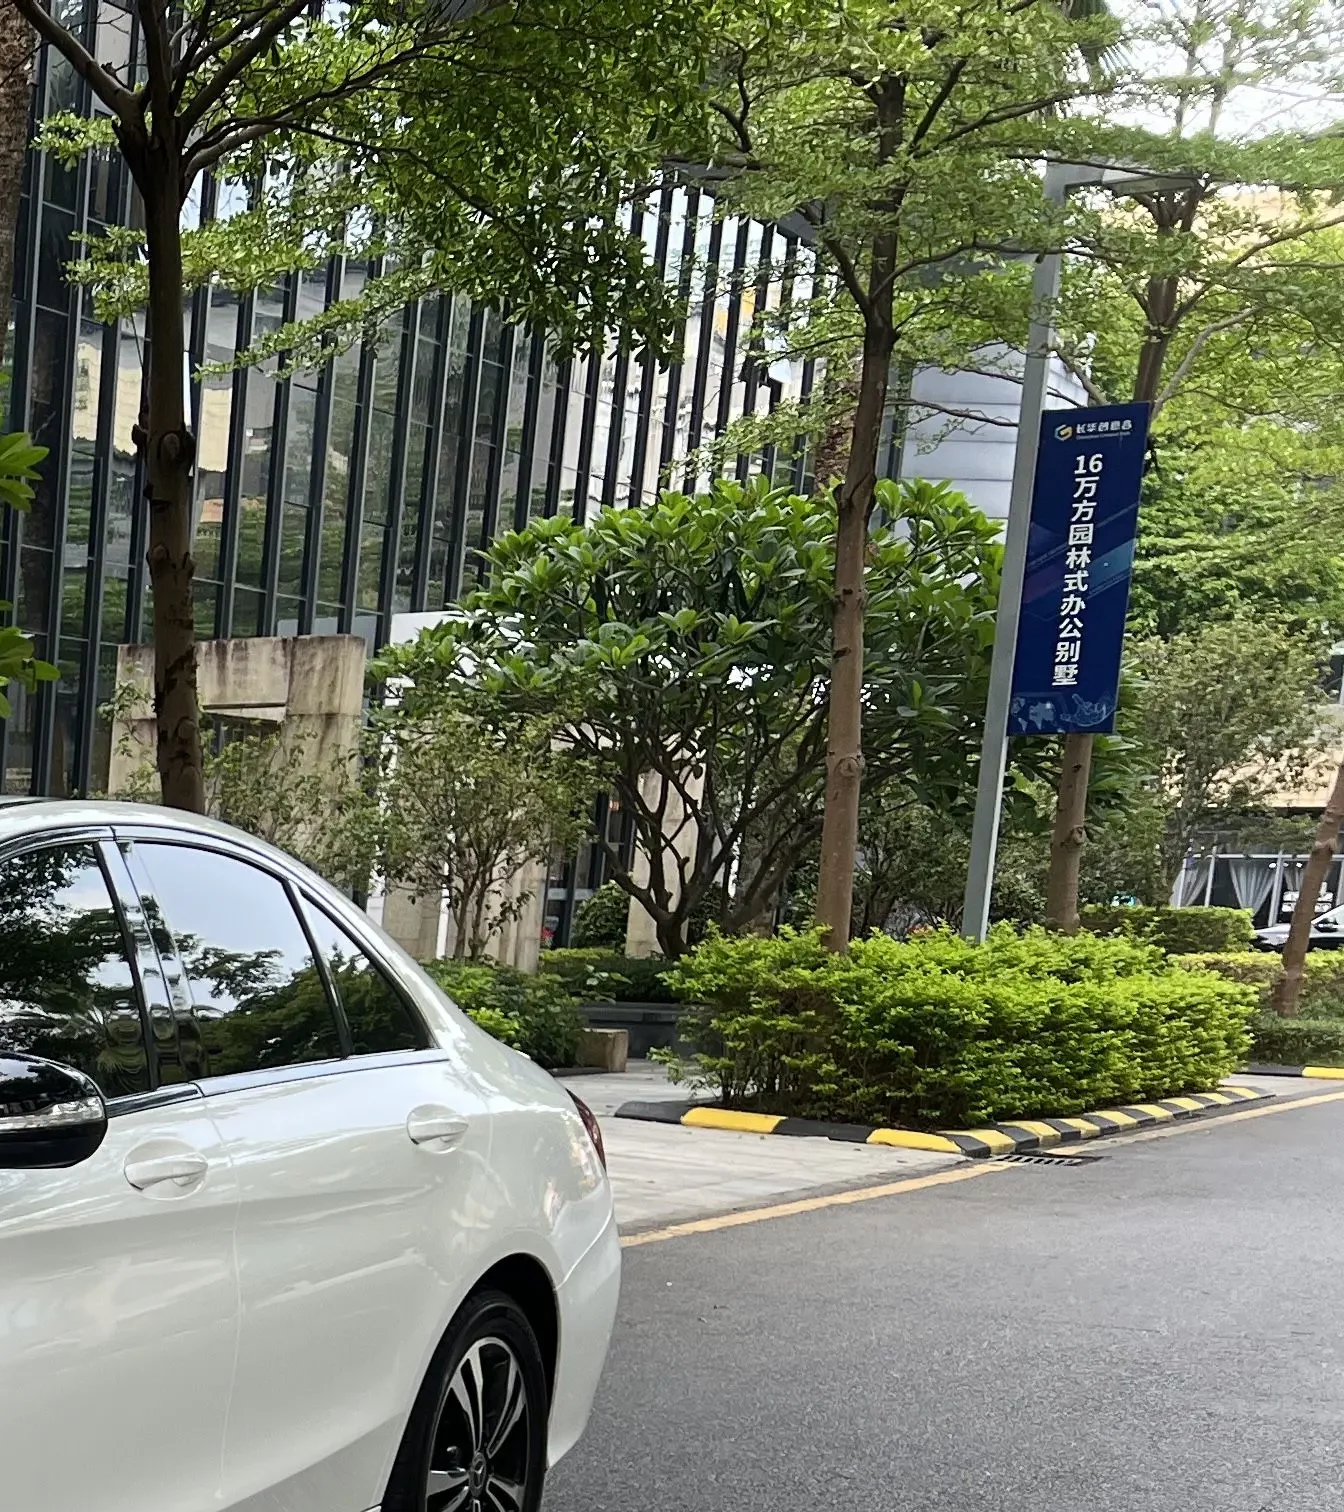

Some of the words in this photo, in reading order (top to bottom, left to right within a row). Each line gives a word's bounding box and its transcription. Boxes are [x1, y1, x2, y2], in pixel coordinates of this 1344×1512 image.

[1052, 453, 1104, 687] 16万方园林式办公别墅
